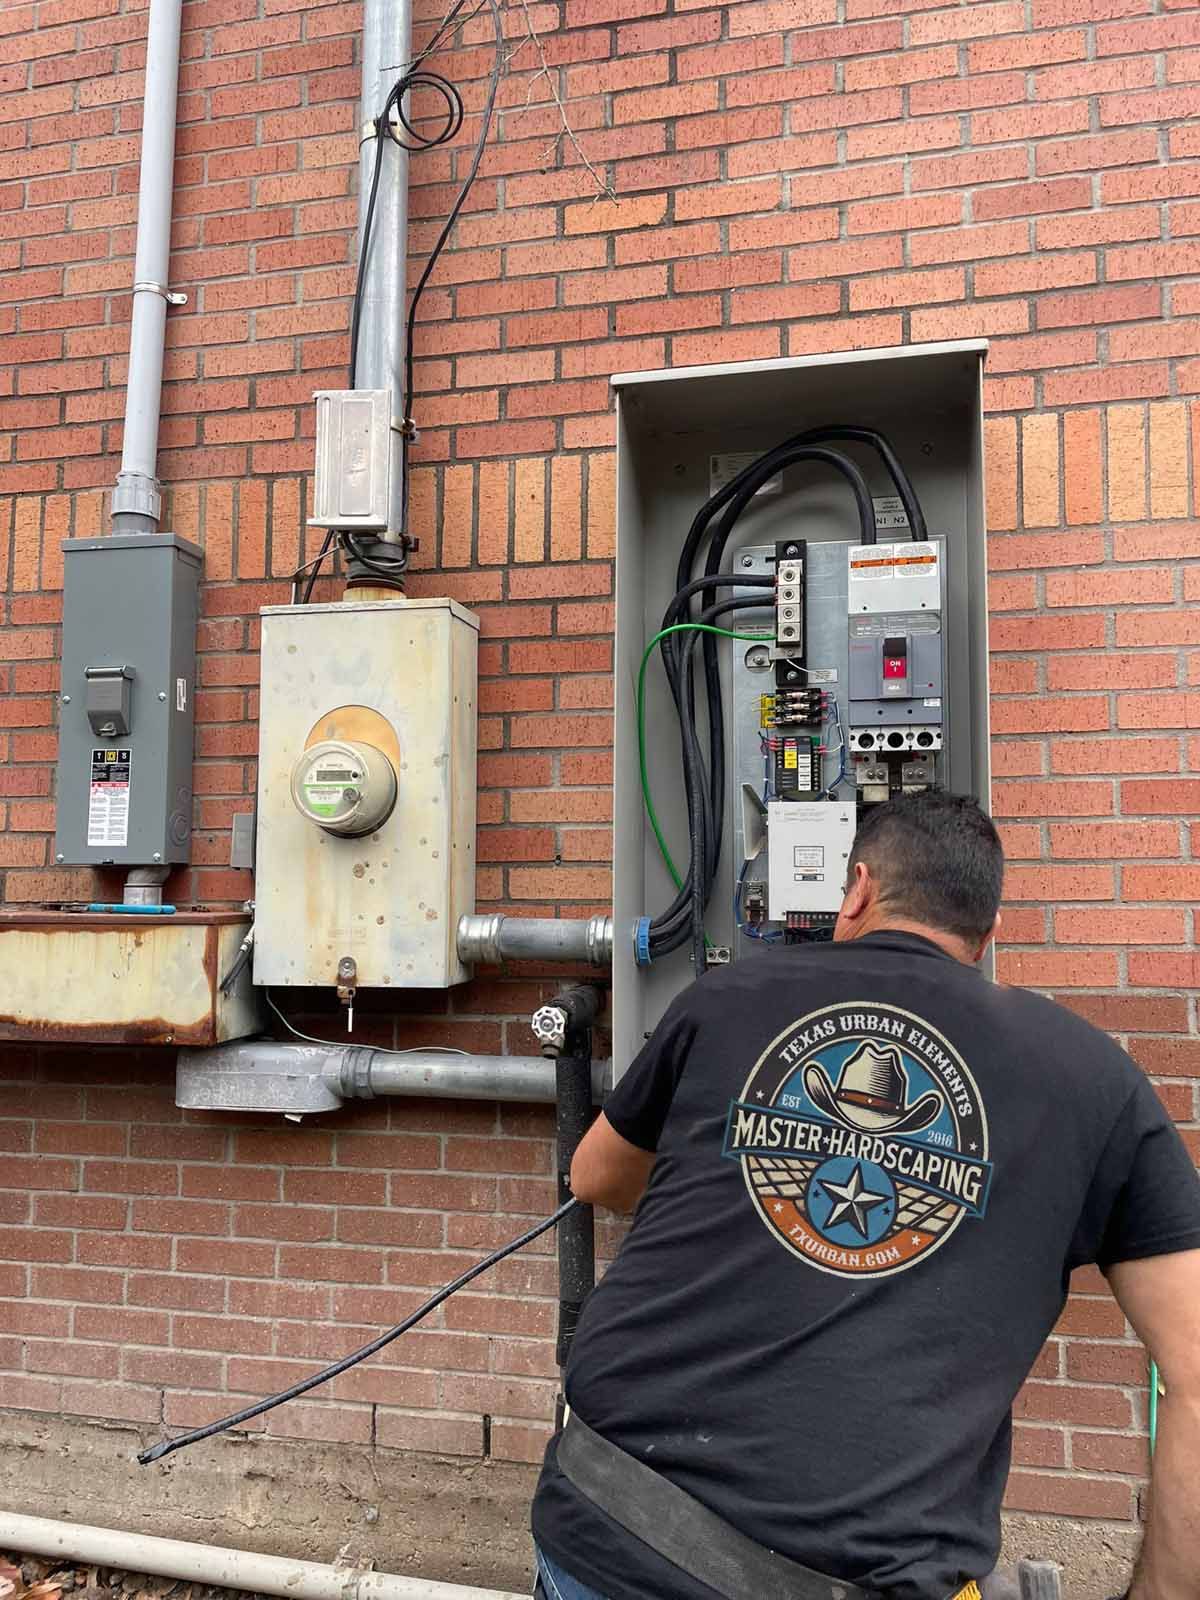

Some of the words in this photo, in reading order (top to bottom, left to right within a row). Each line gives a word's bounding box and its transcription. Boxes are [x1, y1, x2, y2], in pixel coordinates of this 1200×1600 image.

[894, 516, 905, 524] N2
[778, 1019, 837, 1065] TEXAS
[840, 1014, 906, 1039] URBAN
[907, 1028, 973, 1118] ELEMENTS
[782, 1094, 802, 1110] EST
[926, 1129, 953, 1147] 2016
[732, 1109, 823, 1152] MASTER
[827, 1127, 983, 1205] HARDSCAPING
[787, 1223, 902, 1267] TXURBAN.COM
